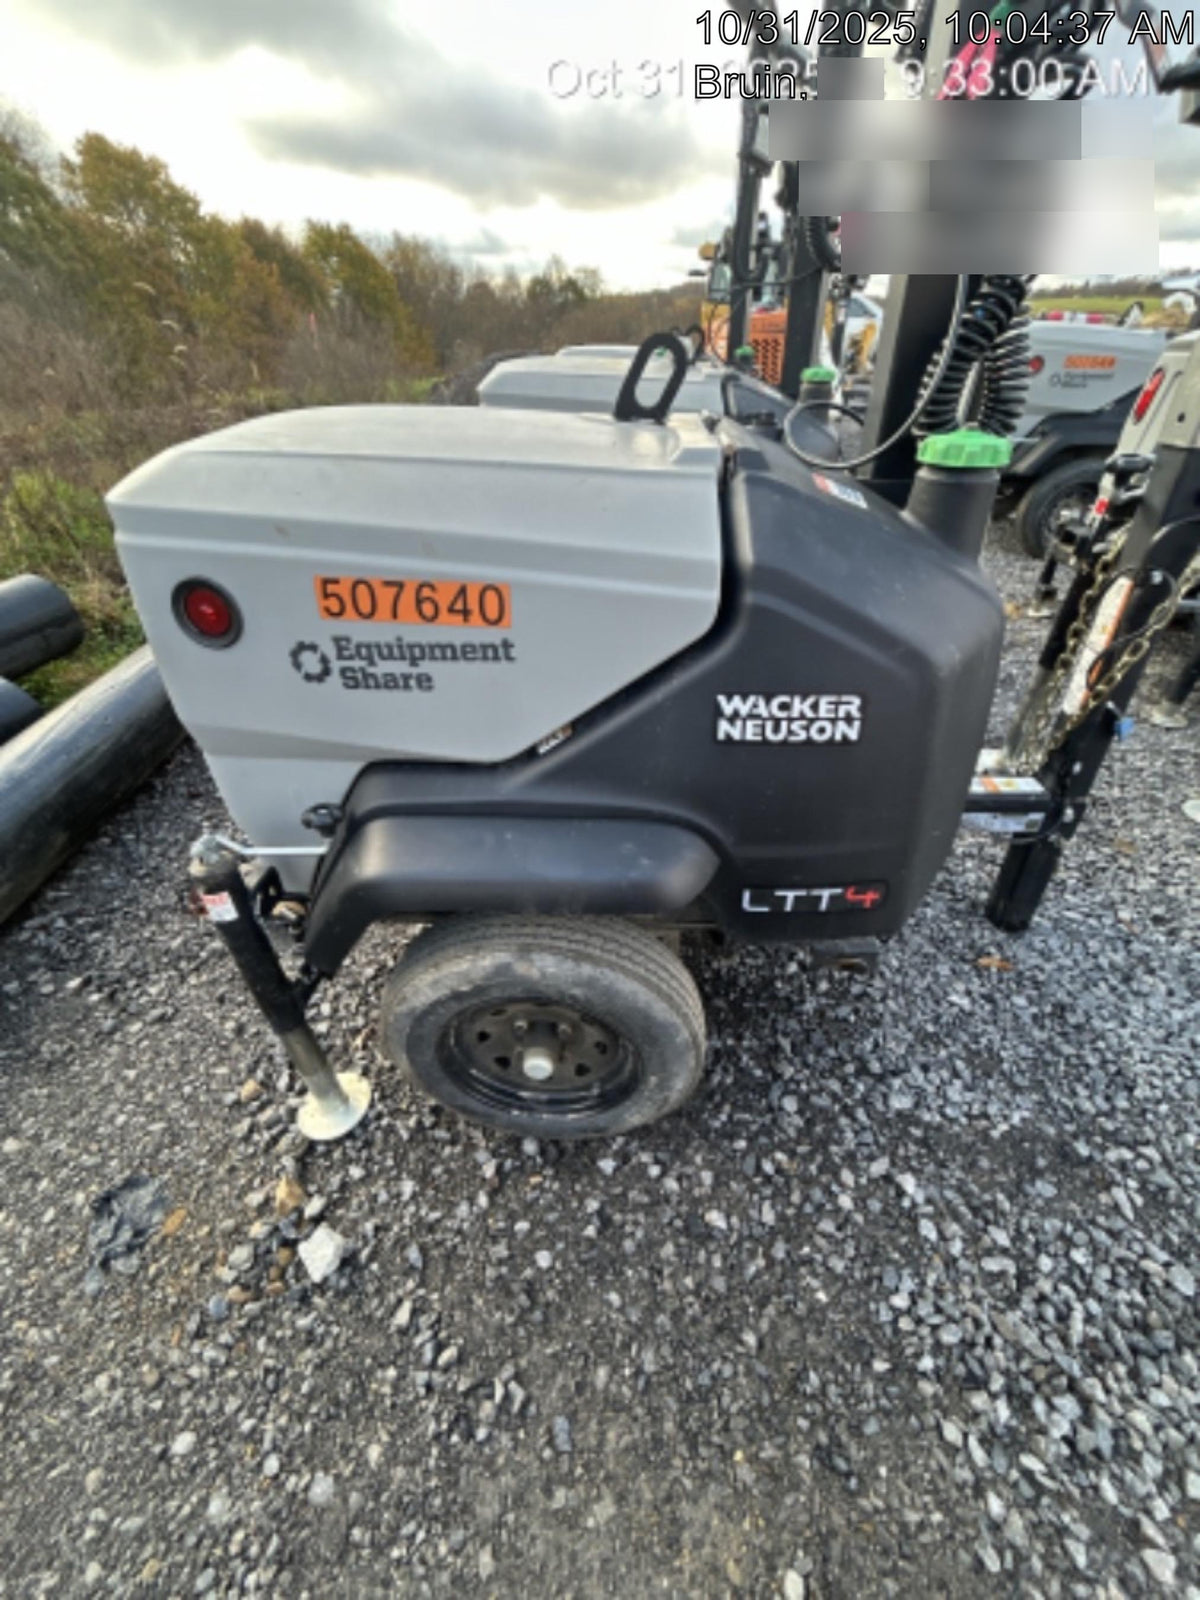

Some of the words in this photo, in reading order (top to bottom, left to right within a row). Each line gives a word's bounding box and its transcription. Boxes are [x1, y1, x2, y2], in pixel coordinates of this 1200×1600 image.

[320, 577, 506, 626] 507640
[331, 635, 516, 668] Equipment
[338, 665, 435, 692] Share
[716, 694, 862, 719] WACKER
[716, 719, 861, 742] NEUSON
[741, 885, 882, 913] LTT4
